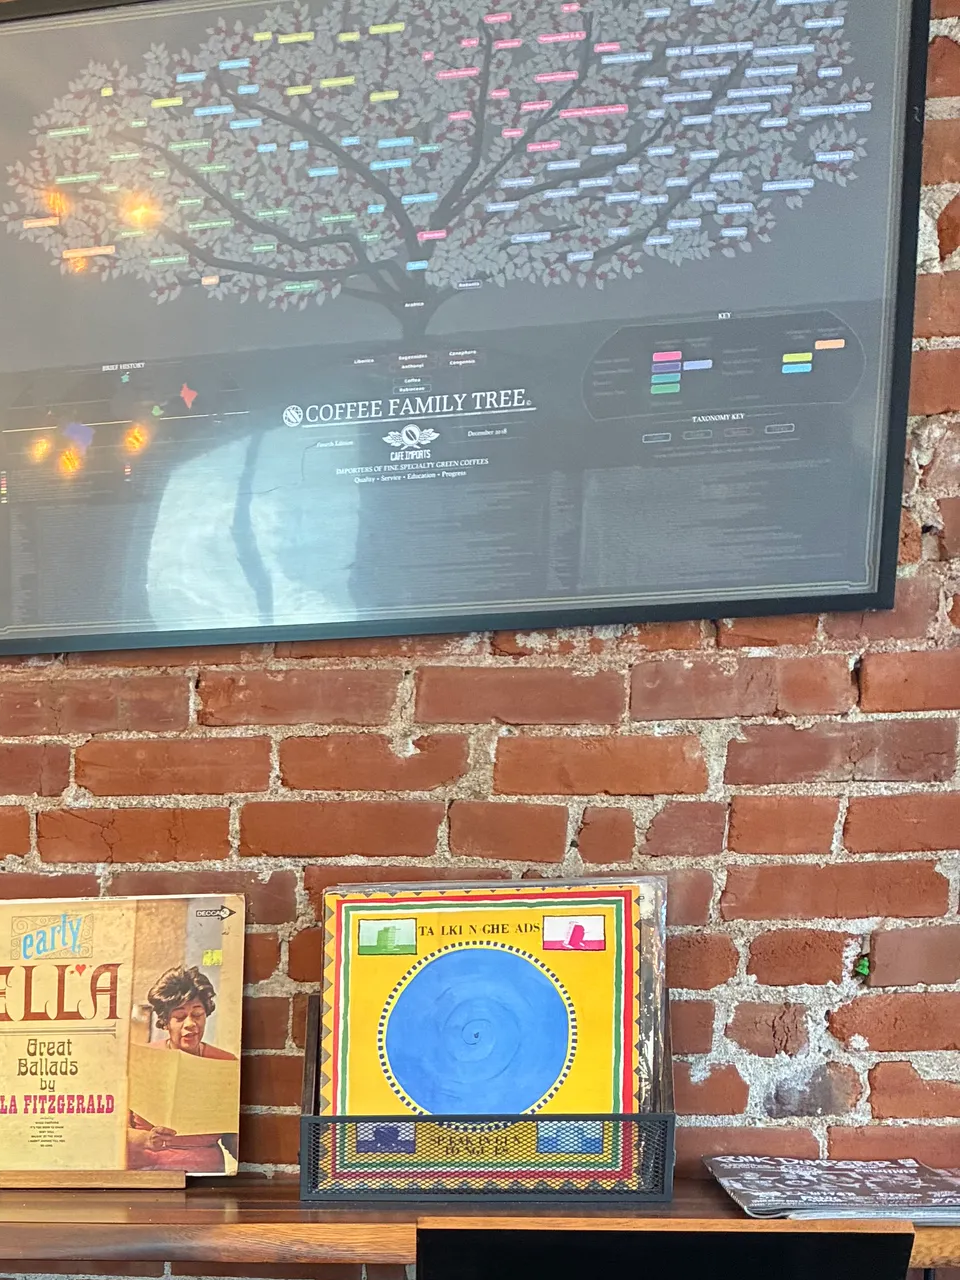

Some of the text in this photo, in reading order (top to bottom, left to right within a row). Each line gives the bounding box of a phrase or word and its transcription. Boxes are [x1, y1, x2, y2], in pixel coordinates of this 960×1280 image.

[305, 388, 526, 423] COFFEE FAMILY TREE
[692, 412, 746, 423] TAXONOMY KEY
[21, 913, 83, 960] early
[26, 1038, 72, 1057] Great
[17, 1058, 79, 1076] Ballads
[39, 1078, 56, 1092] by
[23, 1094, 115, 1114] FITZGERALD
